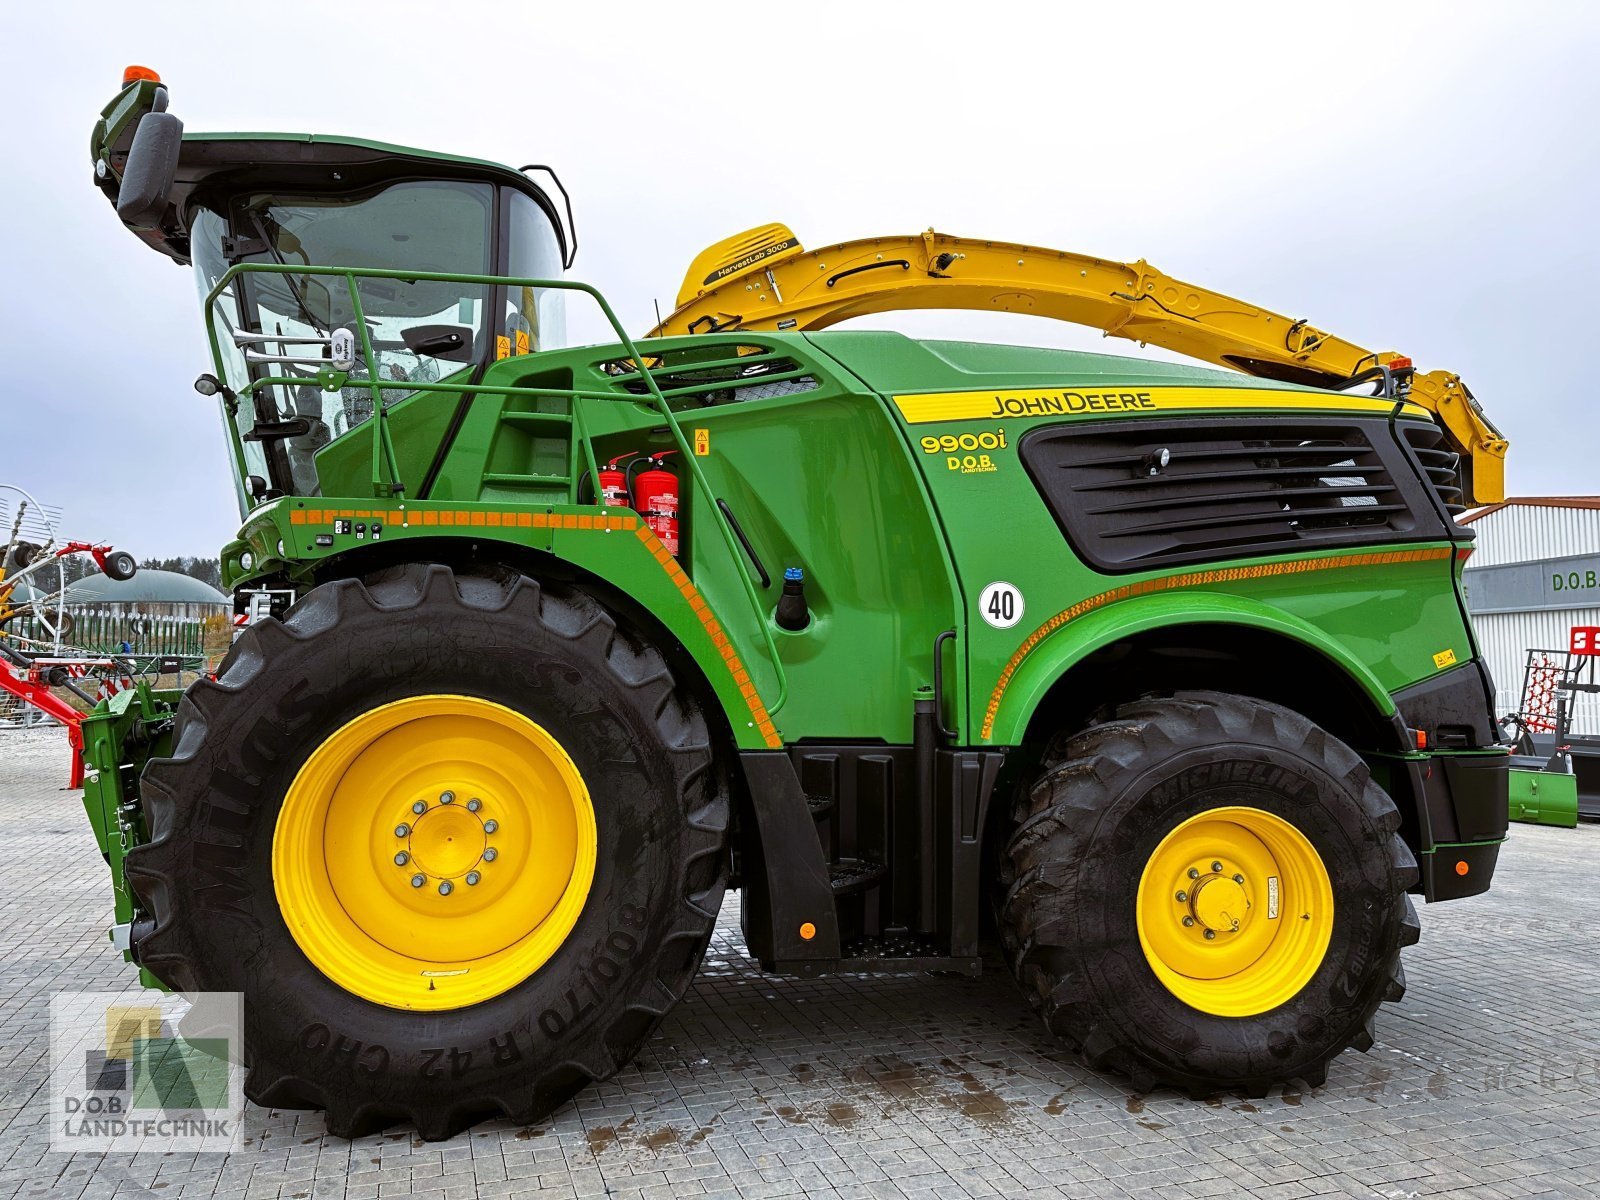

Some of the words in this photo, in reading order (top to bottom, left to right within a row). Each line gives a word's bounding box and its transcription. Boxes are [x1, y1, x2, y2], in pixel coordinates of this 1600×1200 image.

[718, 251, 765, 277] HarvestLab
[766, 242, 788, 255] 3000
[991, 396, 1064, 416] JOHN
[1063, 392, 1156, 411] DEERE
[920, 428, 1008, 454] 9900i
[947, 454, 994, 471] D.O.B.
[988, 590, 1014, 621] 40
[537, 902, 649, 1041] 800/70
[301, 1022, 391, 1081] CHO
[419, 1047, 474, 1080] 42
[489, 1031, 522, 1066] R
